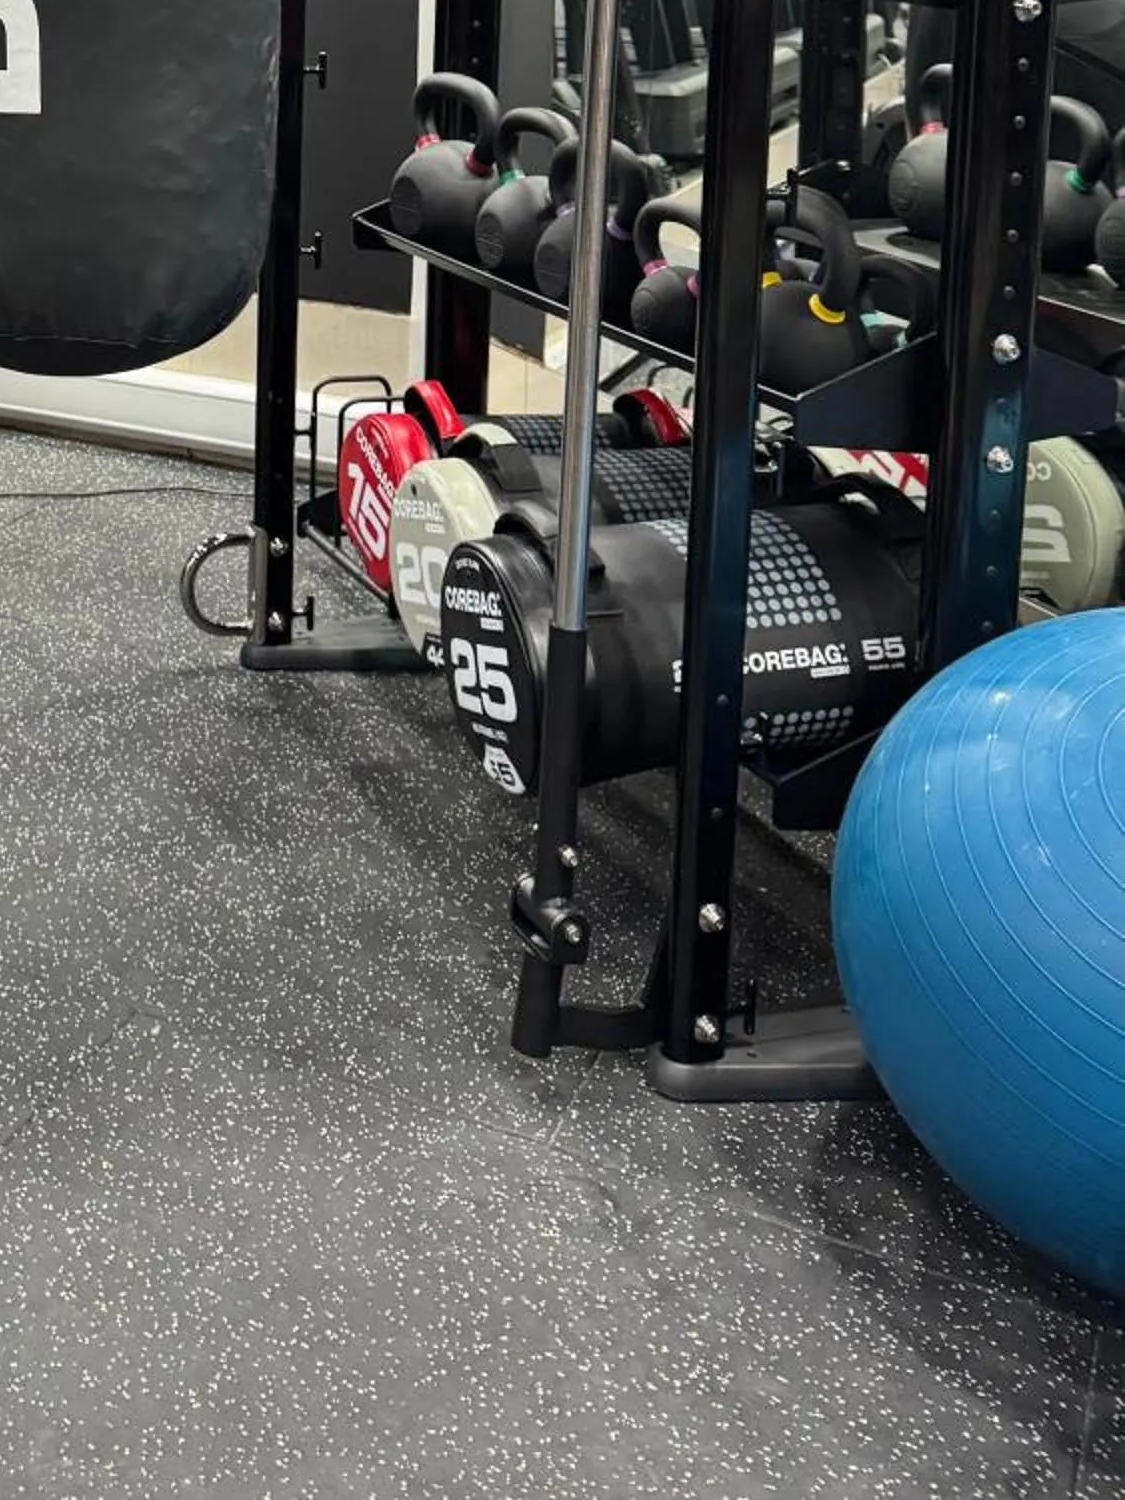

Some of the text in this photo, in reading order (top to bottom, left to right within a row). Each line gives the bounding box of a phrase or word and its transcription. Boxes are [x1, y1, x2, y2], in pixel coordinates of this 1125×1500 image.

[347, 462, 390, 561] 15
[396, 541, 448, 608] 20
[450, 637, 518, 722] 25
[861, 636, 906, 661] 55
